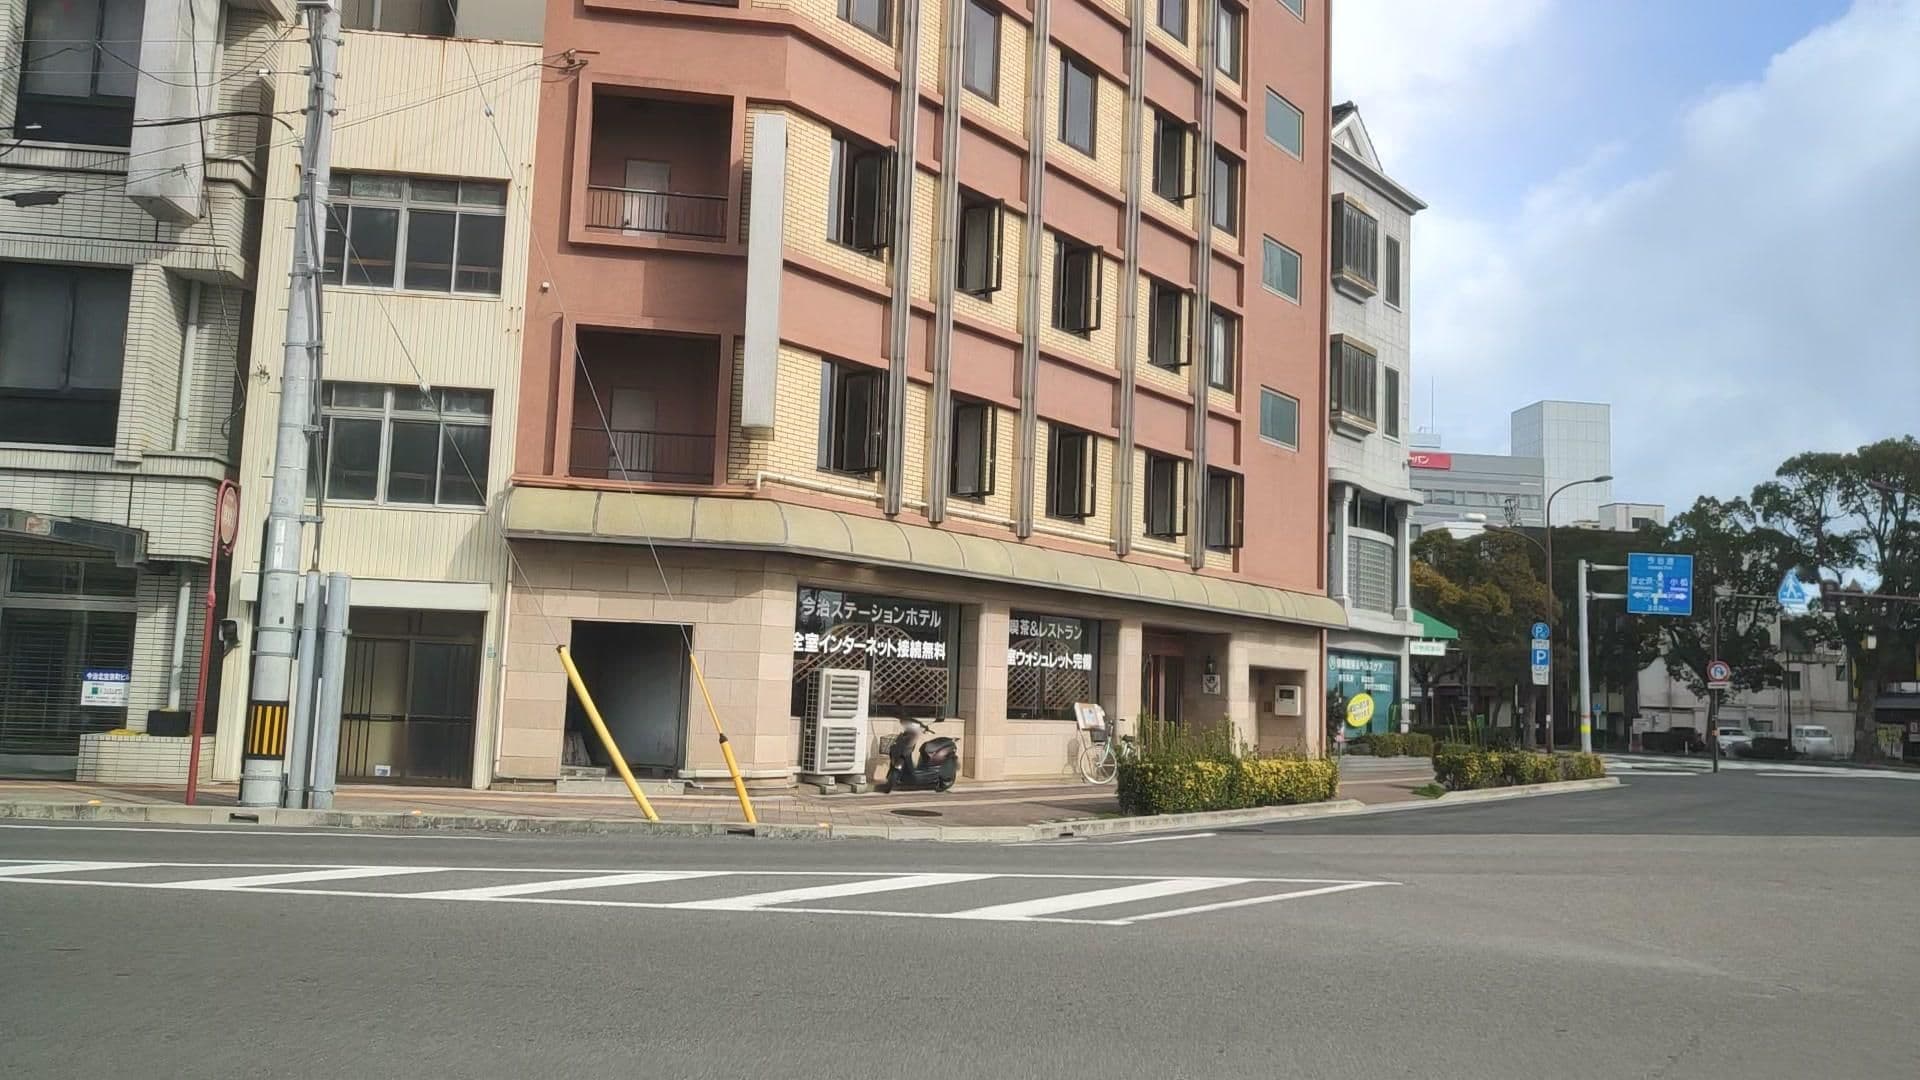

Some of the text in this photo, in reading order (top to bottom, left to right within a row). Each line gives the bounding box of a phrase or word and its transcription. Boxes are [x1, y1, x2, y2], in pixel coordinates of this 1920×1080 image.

[801, 596, 942, 628] 今治ステーションホテル
[793, 631, 946, 661] 全室インターネット接続無料
[1536, 650, 1547, 665] P
